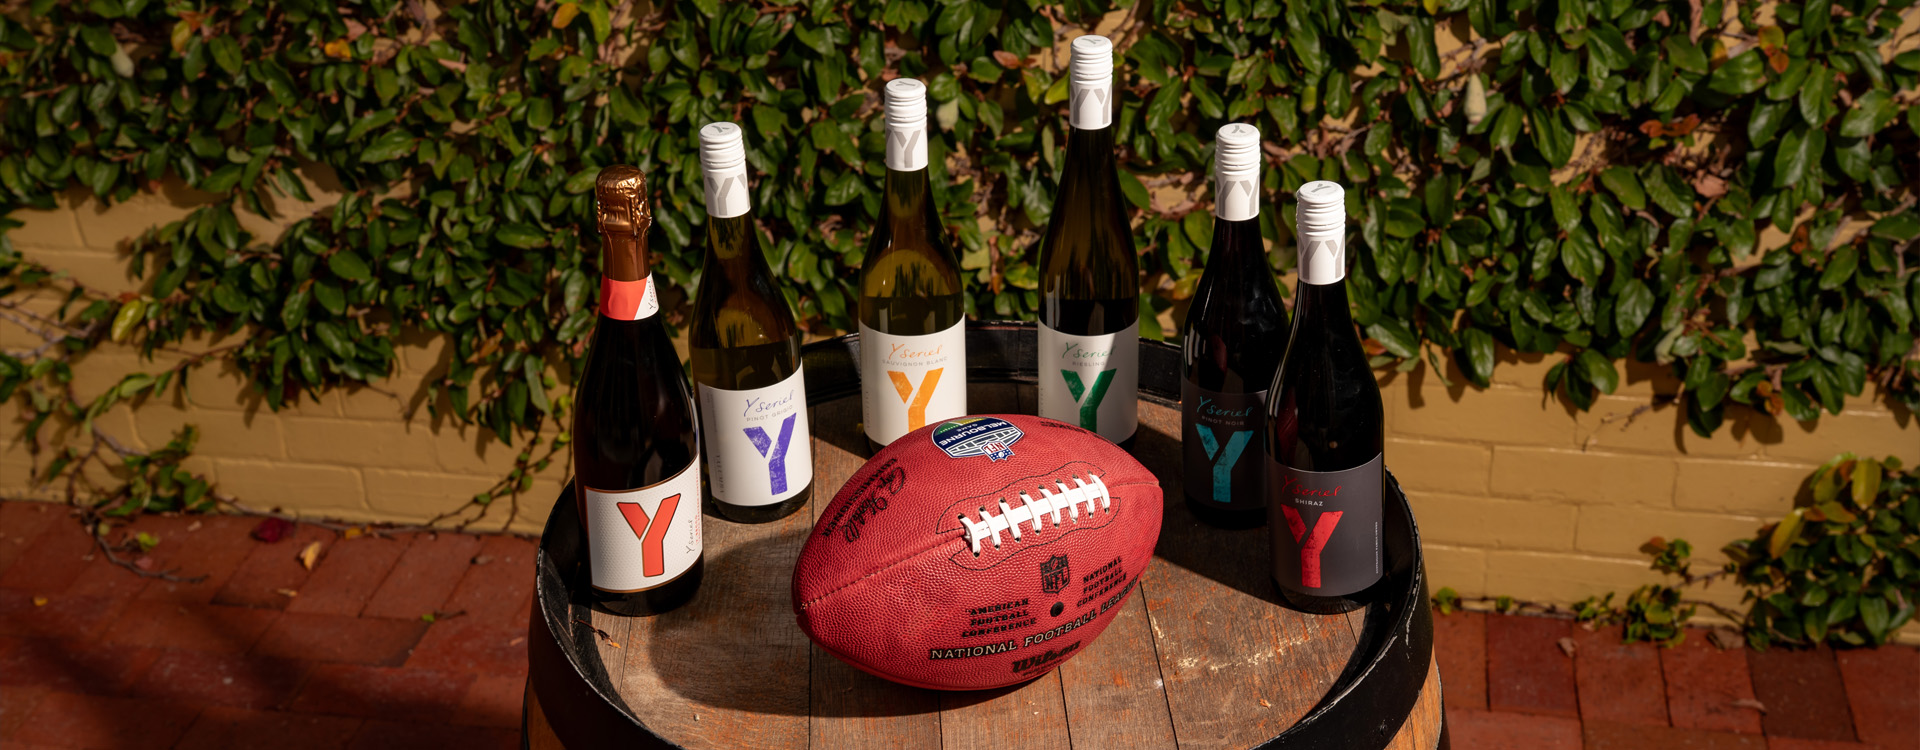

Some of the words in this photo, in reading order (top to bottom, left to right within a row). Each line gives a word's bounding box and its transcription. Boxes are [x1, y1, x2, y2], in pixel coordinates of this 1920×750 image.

[893, 129, 921, 168] Y
[706, 176, 735, 216] Y
[881, 359, 924, 367] SAUVIGNON
[926, 356, 948, 366] BLANC
[747, 414, 769, 422] PINOT
[771, 404, 793, 417] GRIGIO
[886, 367, 945, 433] Y
[1060, 368, 1118, 433] Y
[938, 421, 1008, 446] MELBOURNE
[1201, 415, 1222, 424] PINOT
[742, 412, 798, 496] Y
[983, 442, 1007, 454] NFL
[1195, 423, 1255, 503] Y
[821, 458, 897, 537] COMMISSIONER
[1295, 498, 1324, 507] SHIRAZ
[615, 492, 682, 578] Y
[1280, 503, 1344, 588] Y
[1043, 569, 1069, 591] NFL
[1082, 556, 1123, 584] NATIONAL
[1082, 568, 1124, 595] FOOTBALL
[1076, 572, 1127, 608] CONFERENCE
[969, 598, 1029, 616] AMERICAN
[970, 609, 1029, 627] FOOTBALL
[929, 639, 1019, 660] NATIONAL
[1023, 608, 1098, 648] FOOTBALL
[961, 618, 1038, 638] CONFERENCE
[1012, 640, 1082, 674] Wilson
